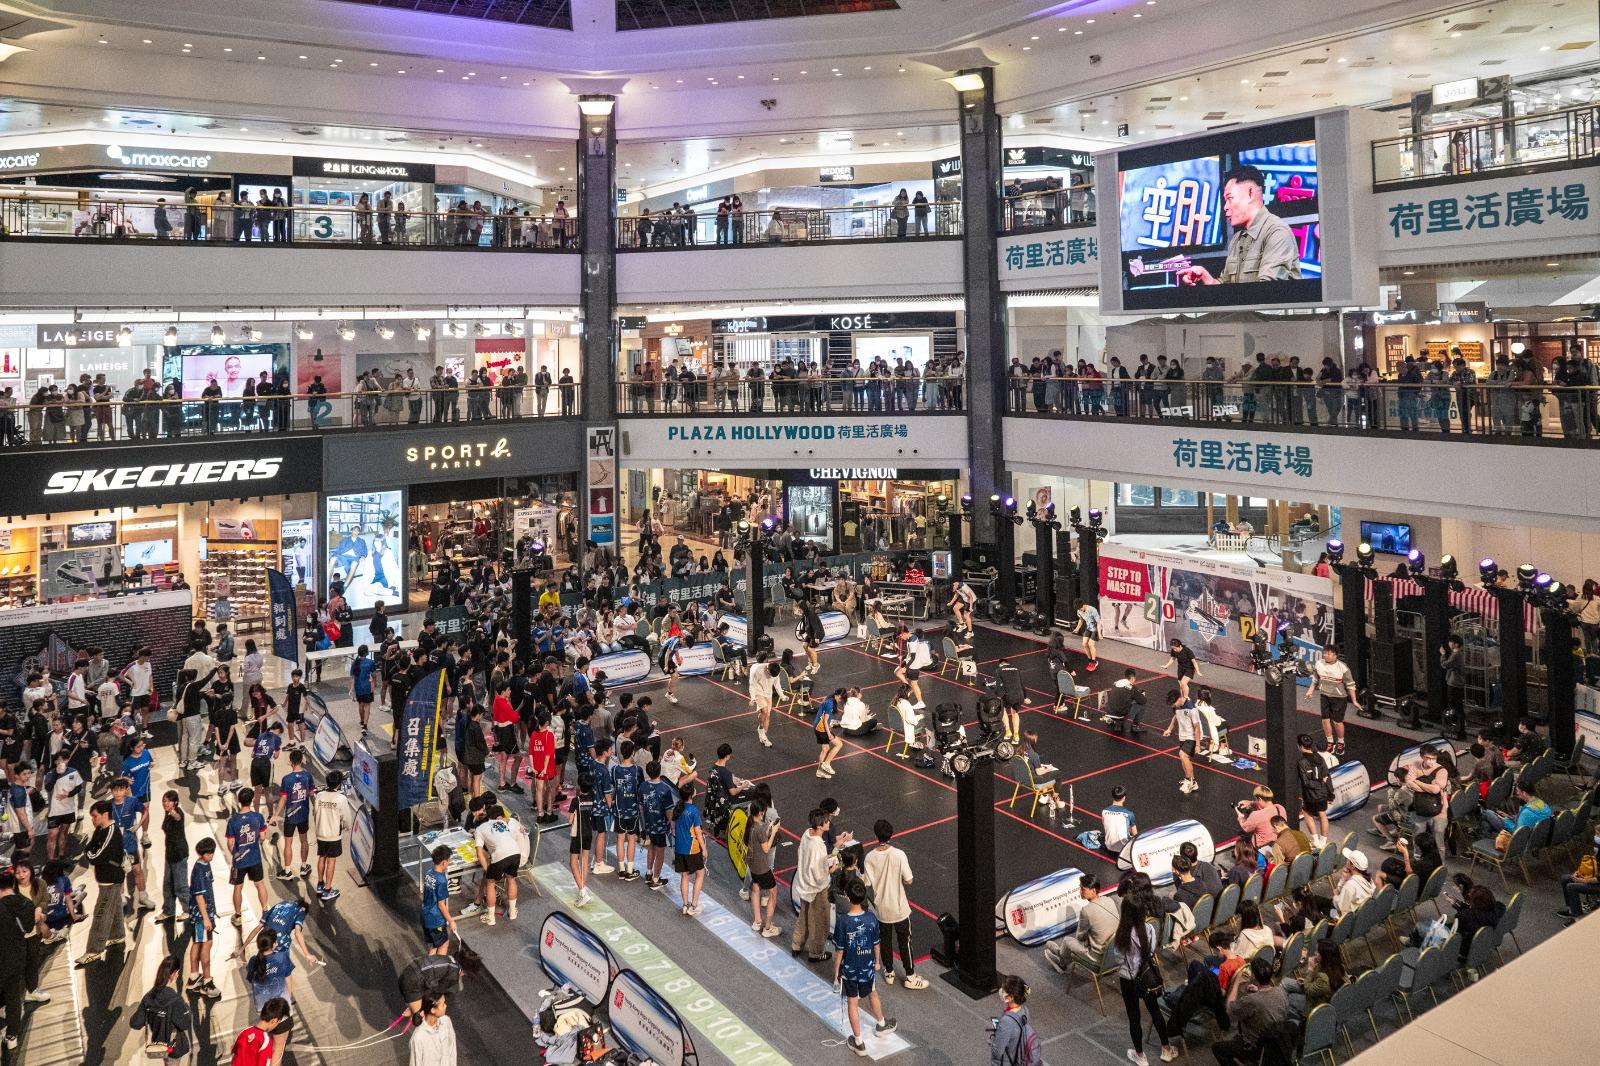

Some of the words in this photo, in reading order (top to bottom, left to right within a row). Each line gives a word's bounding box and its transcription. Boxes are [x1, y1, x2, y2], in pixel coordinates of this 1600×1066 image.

[132, 154, 211, 168] maxcare
[351, 165, 376, 174] KING
[384, 167, 408, 176] KOIL
[1389, 183, 1590, 238] 荷里活廣場
[314, 216, 333, 238] 3
[621, 319, 626, 327] 2
[831, 313, 872, 329] KOSÉ
[43, 330, 114, 342] LAEIGE
[486, 357, 512, 368] benefit
[313, 401, 334, 424] 2
[668, 426, 726, 441] PLAZA
[731, 425, 835, 440] HOLLYWOOD
[837, 424, 908, 440] 荷里活廣場
[406, 443, 487, 462] SPORT
[1173, 437, 1314, 477] 荷里活廣場
[431, 459, 481, 470] PARIS
[44, 457, 283, 495] SKECHERS
[810, 468, 897, 479] CHEVIGNON
[1107, 566, 1126, 580] STEP
[1127, 570, 1141, 583] TO
[1106, 579, 1141, 597] MASTER
[273, 602, 287, 640] 報到處
[1146, 597, 1156, 620] 2
[1163, 603, 1175, 620] 0
[1244, 620, 1255, 639] 2
[966, 664, 972, 673] 2
[402, 717, 421, 776] 召集處
[1253, 743, 1260, 752] 4
[624, 943, 650, 955] 6
[751, 948, 778, 961] 8
[643, 960, 672, 971] 7
[664, 979, 692, 993] 8
[686, 1000, 715, 1013] 9
[706, 1015, 743, 1040] 10
